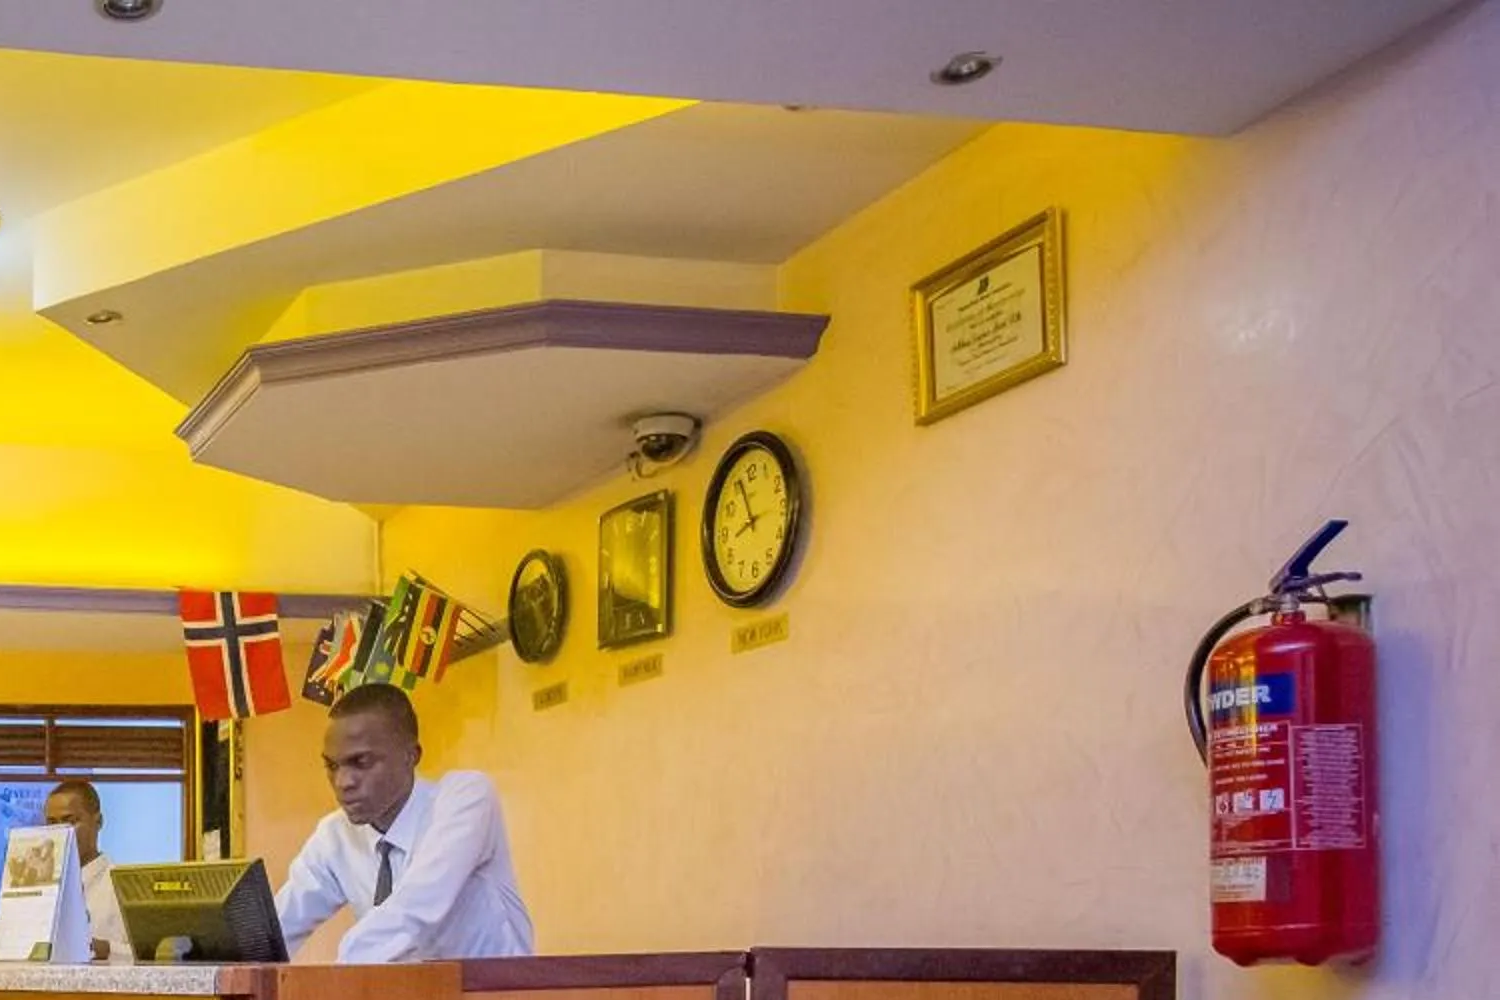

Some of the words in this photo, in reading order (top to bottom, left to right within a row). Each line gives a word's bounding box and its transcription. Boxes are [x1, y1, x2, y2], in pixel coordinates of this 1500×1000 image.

[746, 463, 757, 482] 12
[773, 475, 782, 495] 2
[737, 559, 746, 579] 7
[751, 560, 760, 579] 6
